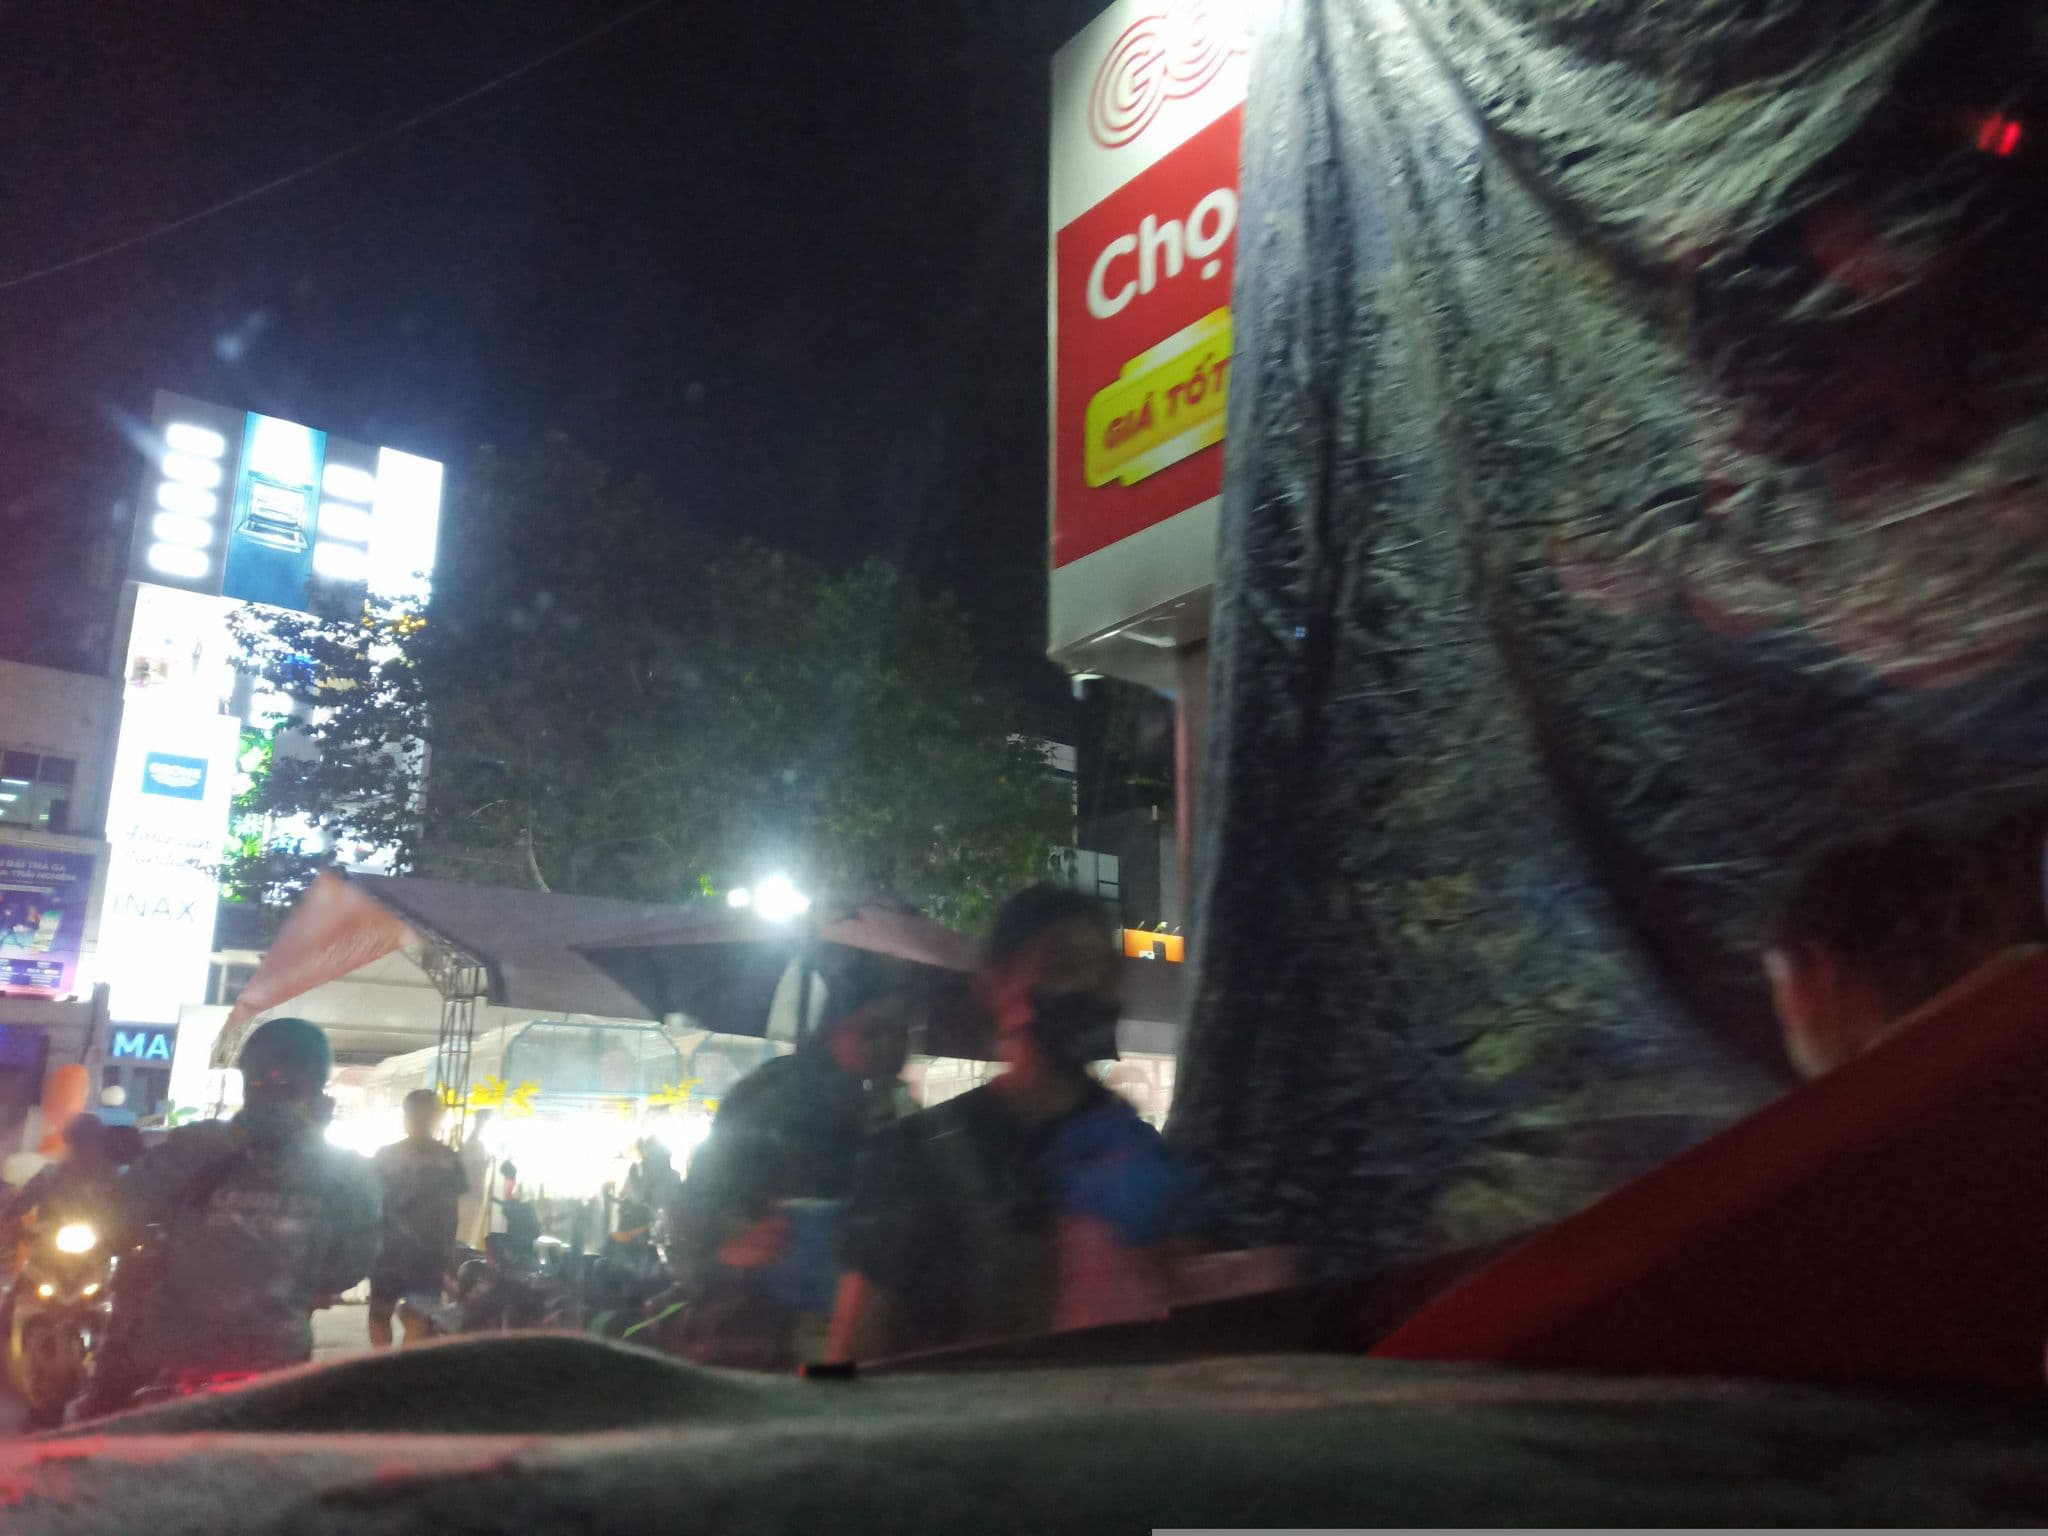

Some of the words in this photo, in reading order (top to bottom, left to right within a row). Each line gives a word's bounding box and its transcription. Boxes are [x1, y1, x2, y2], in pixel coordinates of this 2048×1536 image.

[1086, 187, 1238, 320] Chọ
[1104, 391, 1154, 448] GIÁ
[1166, 353, 1231, 418] TỐT
[113, 1031, 174, 1059] MA
